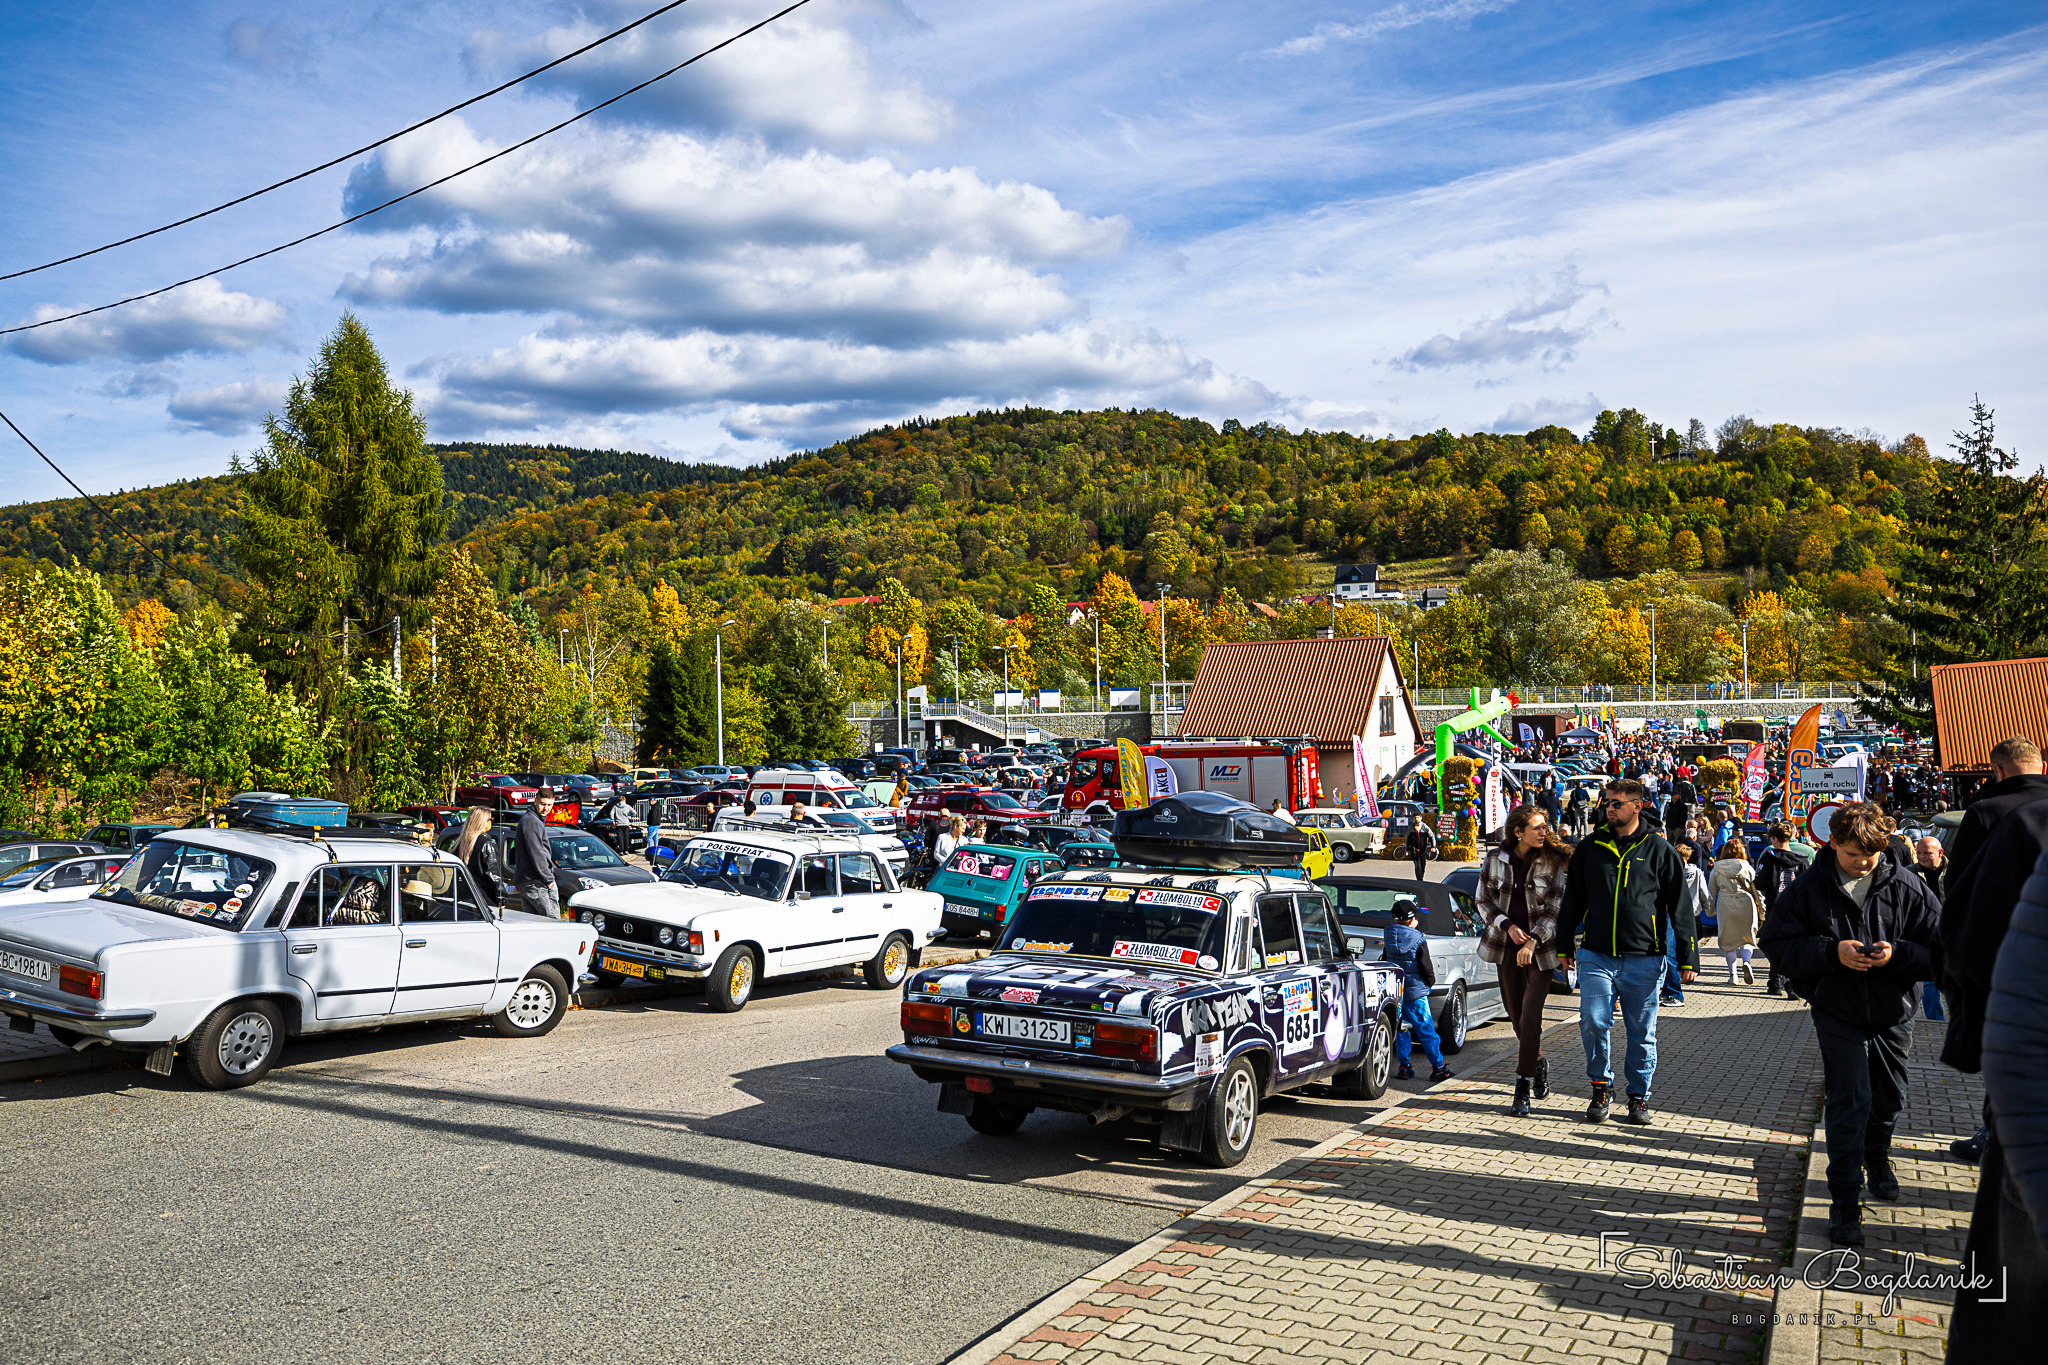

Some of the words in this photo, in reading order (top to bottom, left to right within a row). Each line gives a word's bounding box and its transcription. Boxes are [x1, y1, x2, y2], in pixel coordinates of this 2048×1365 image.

[1803, 781, 1829, 789] Strefa
[1832, 780, 1856, 788] ruchu
[706, 842, 740, 853] POLSKI
[741, 847, 764, 857] FIAT
[18, 956, 48, 980] 1981A
[603, 958, 619, 972] JWA
[620, 962, 632, 975] 3H
[1212, 992, 1254, 1029] TEAM
[984, 1013, 1011, 1036] KWI
[1019, 1018, 1067, 1042] 3125J
[1286, 1012, 1311, 1044] 683
